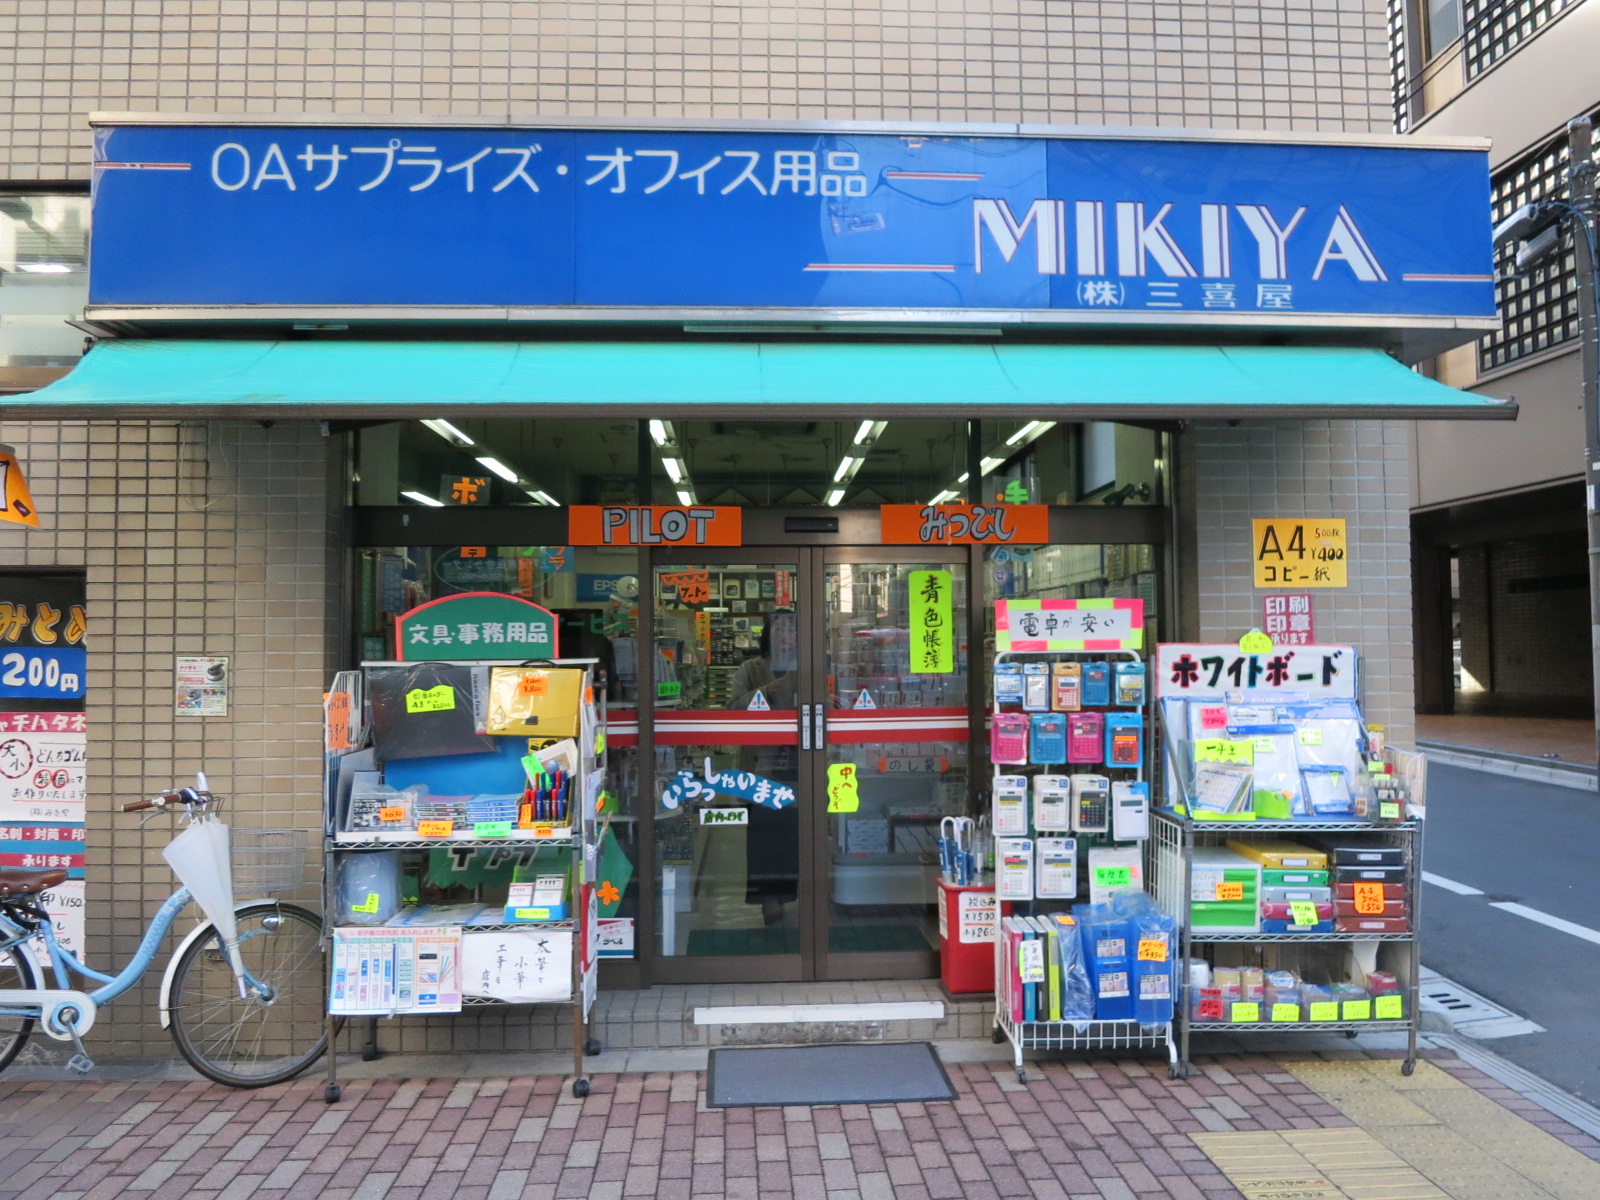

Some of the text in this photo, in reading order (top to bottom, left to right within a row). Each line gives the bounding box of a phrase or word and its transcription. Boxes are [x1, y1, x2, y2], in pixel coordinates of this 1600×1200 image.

[210, 138, 868, 198] OAサプライズ・オフィス用品
[973, 198, 1389, 282] MIKIYA
[603, 507, 715, 544] PILOT
[919, 506, 1017, 541] みつびし
[1258, 525, 1306, 561] A4
[1264, 566, 1331, 582] コピー紙
[1266, 596, 1309, 614] 印刷
[408, 622, 548, 645] 文具・事務用品
[920, 575, 944, 669] 青色帳簿
[1019, 613, 1114, 637] 電卓が安い
[1267, 614, 1310, 632] 印章
[2, 652, 79, 693] 200円
[1171, 650, 1343, 688] ホワイトボード
[662, 757, 795, 810] いらっしゃいませ
[839, 766, 853, 788] 中へ
[0, 827, 86, 841] 名刺・封筒・印
[22, 854, 73, 867] 承ります
[1359, 887, 1374, 895] A4
